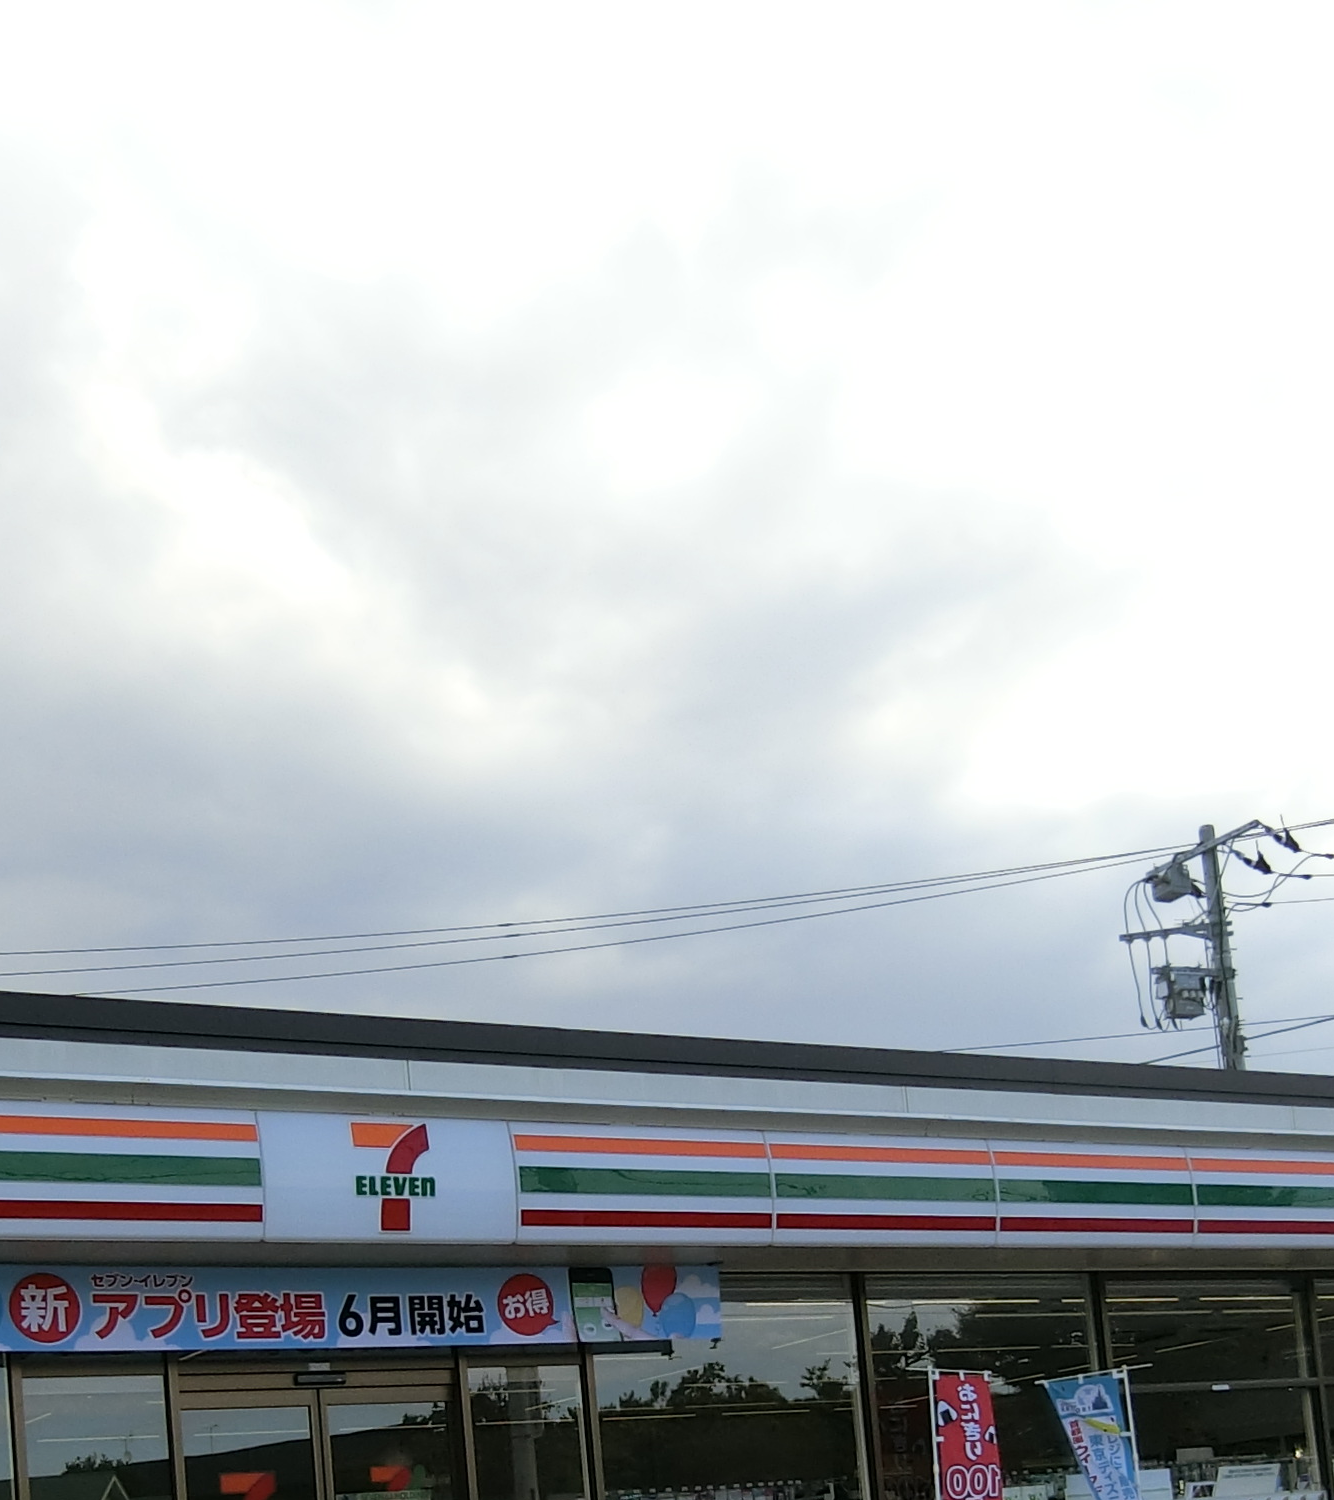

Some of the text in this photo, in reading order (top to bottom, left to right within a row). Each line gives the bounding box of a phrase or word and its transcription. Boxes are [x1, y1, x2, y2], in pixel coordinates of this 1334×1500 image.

[350, 1122, 429, 1232] 7
[19, 1284, 70, 1334] 新
[91, 1290, 485, 1340] アプリ登場 6月開始
[502, 1288, 550, 1320] お得
